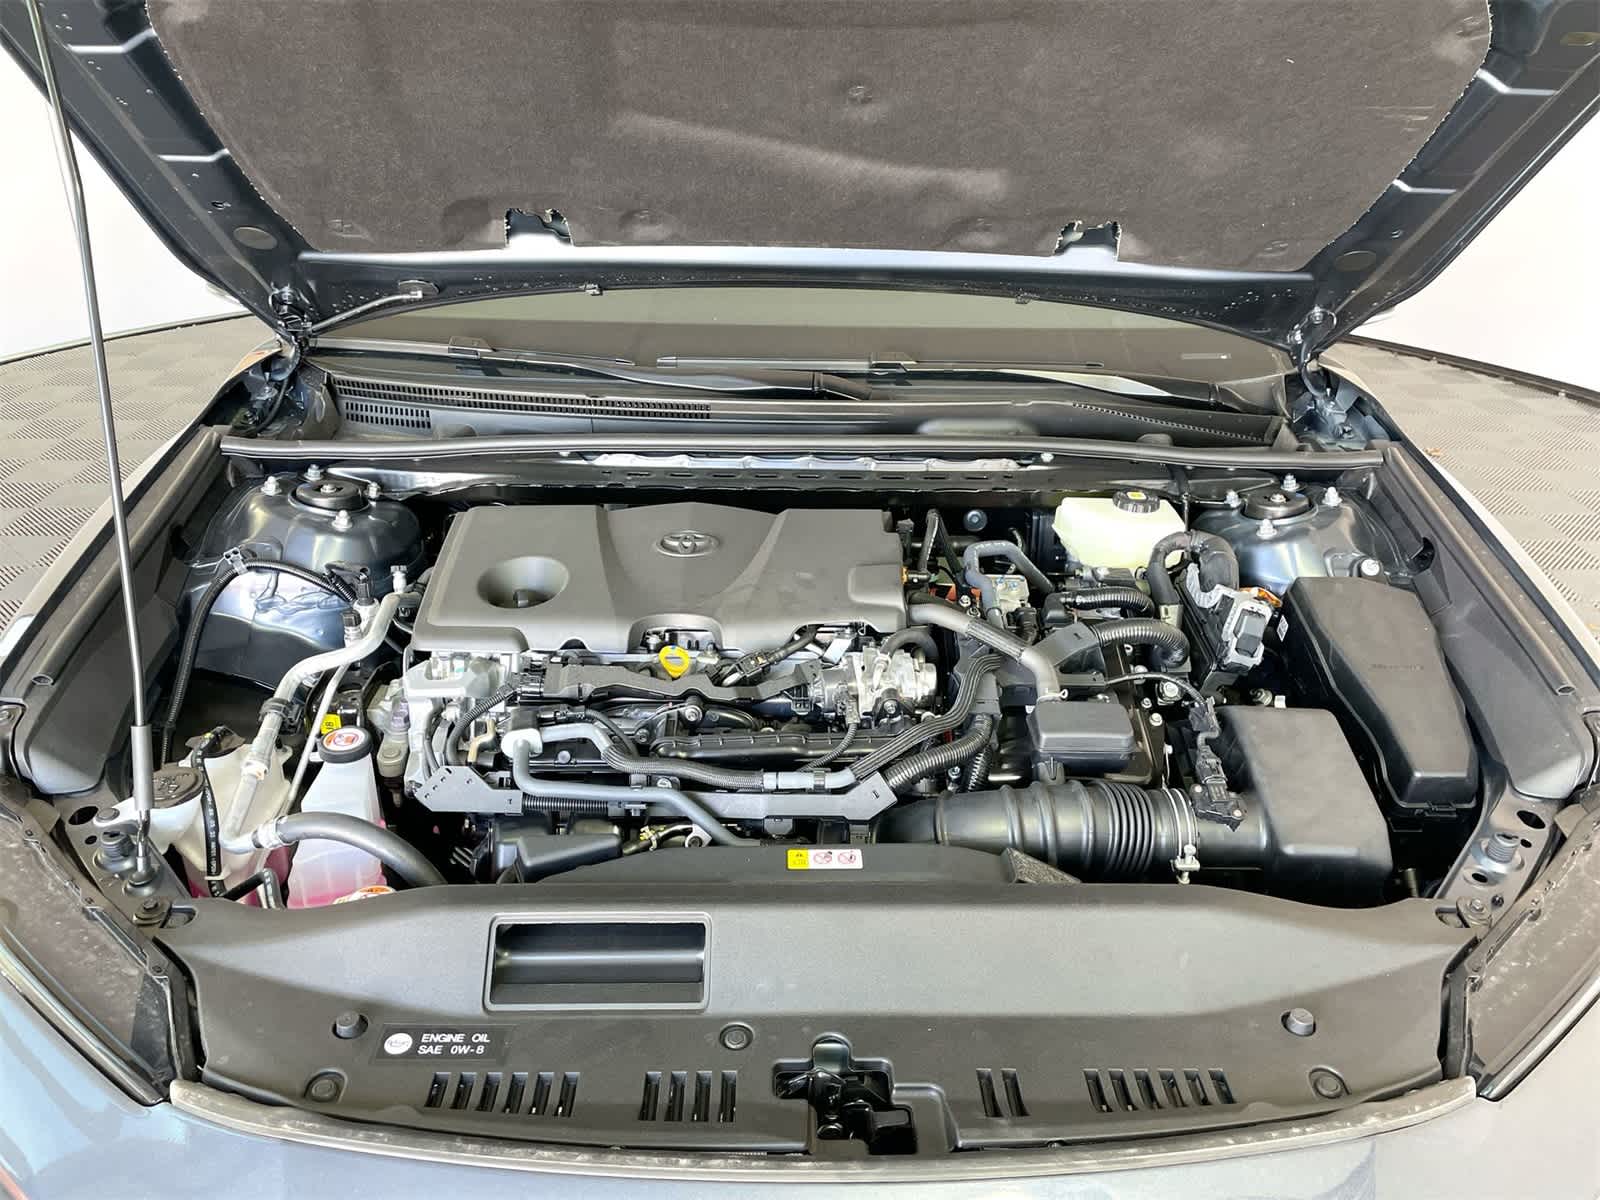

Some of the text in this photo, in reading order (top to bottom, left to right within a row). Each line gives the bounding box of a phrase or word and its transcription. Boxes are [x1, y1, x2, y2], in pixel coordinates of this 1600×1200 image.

[421, 1033, 491, 1043] ENGINE OIL
[417, 1045, 444, 1055] SAE
